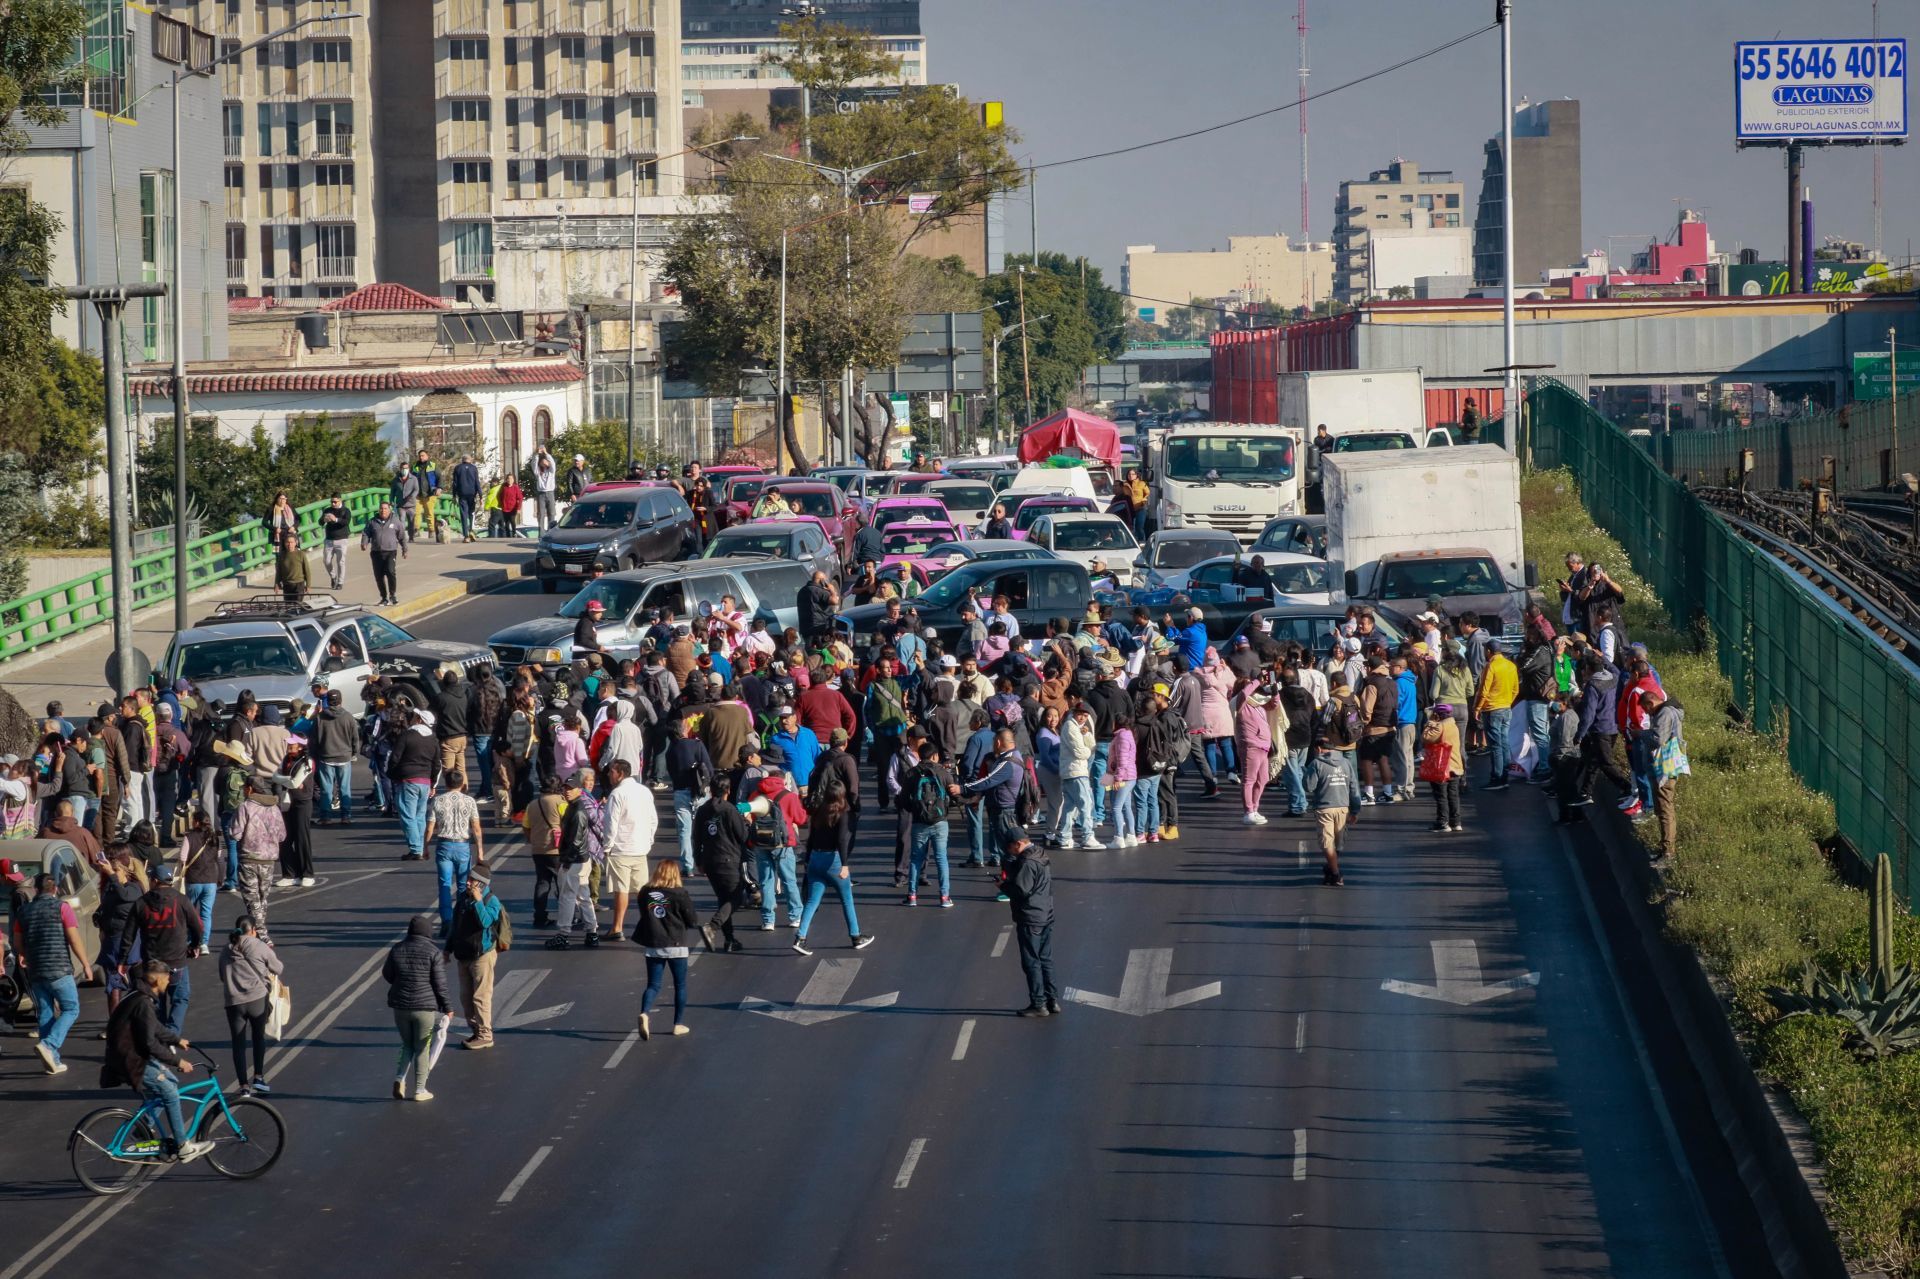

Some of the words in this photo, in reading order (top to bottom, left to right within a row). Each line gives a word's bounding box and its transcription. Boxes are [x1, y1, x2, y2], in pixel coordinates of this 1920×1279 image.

[1742, 48, 1771, 80] 55
[1776, 47, 1837, 79] 5646
[1845, 45, 1903, 78] 4012
[1778, 87, 1870, 104] LAGUNAS
[1777, 108, 1826, 117] PUBLICIDAD
[1827, 107, 1870, 115] EXTERIOR
[1744, 121, 1900, 131] WWW.GRUPOLAGUNAS.COM.MX
[1213, 504, 1246, 512] ISUZU
